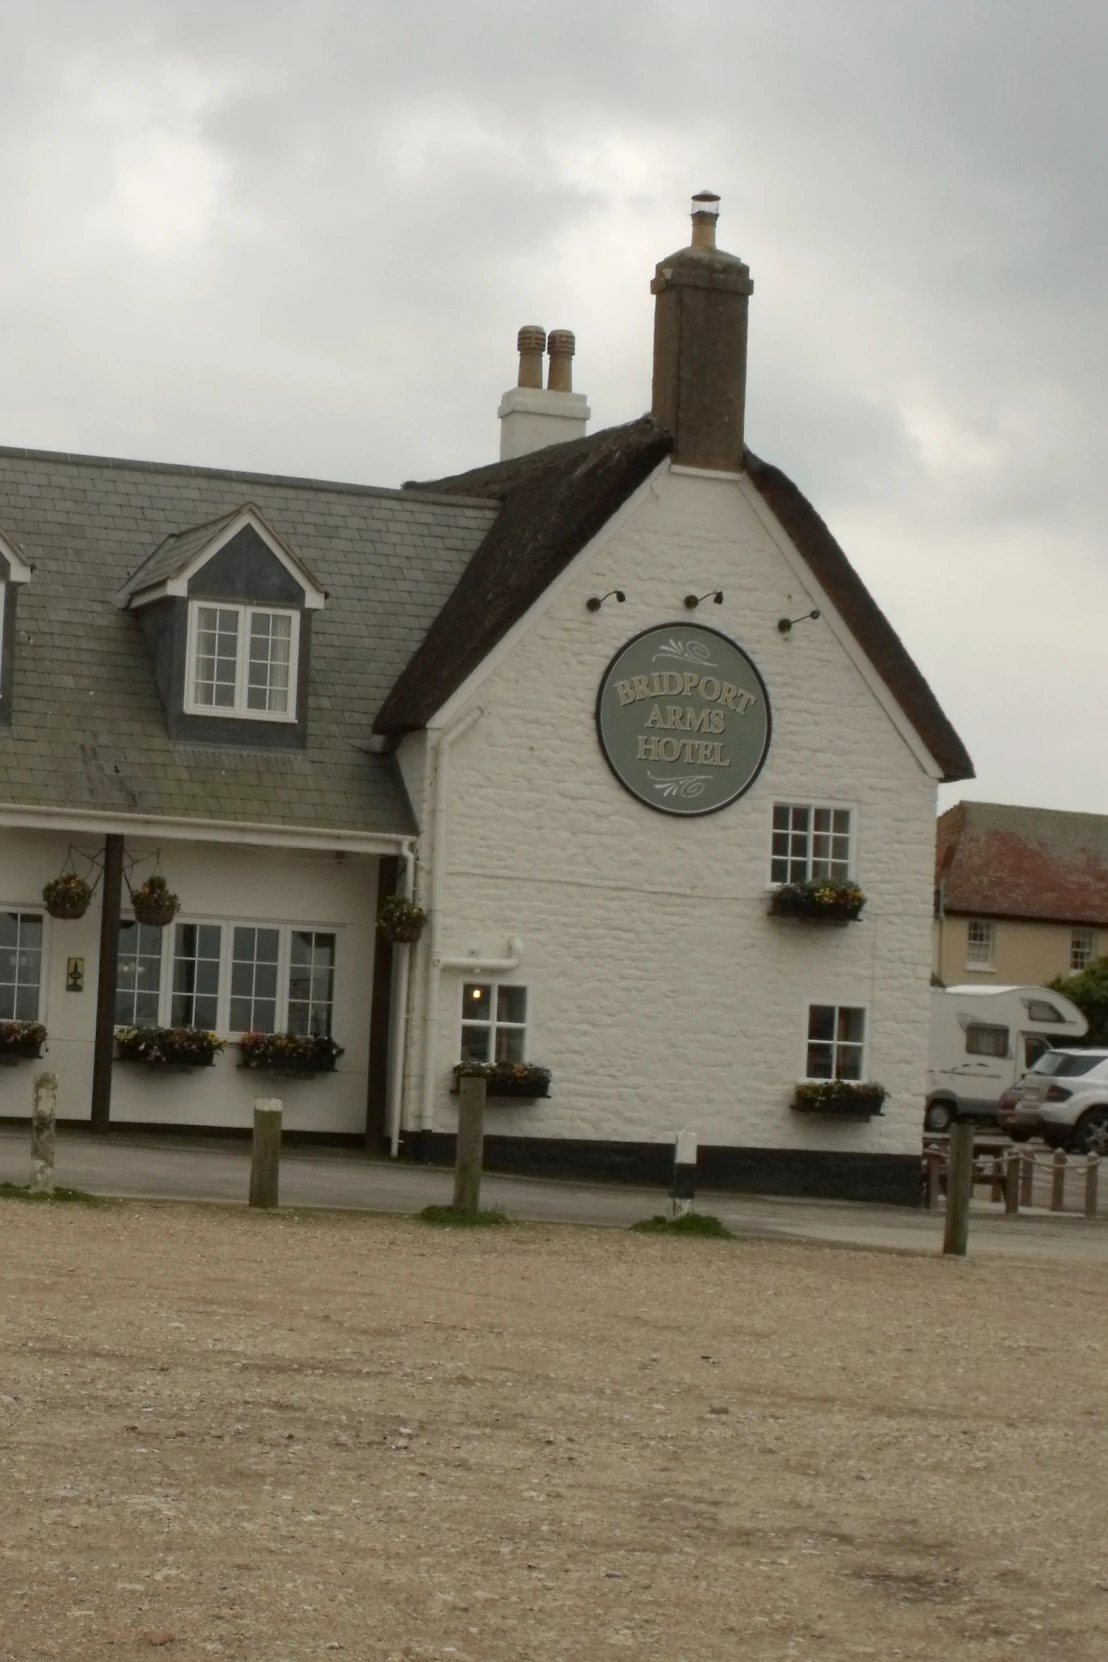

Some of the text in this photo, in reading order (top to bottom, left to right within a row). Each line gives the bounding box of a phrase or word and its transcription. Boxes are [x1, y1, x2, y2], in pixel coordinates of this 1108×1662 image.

[614, 671, 756, 715] BRIDPORT
[644, 704, 726, 734] ARMS
[636, 735, 731, 767] HOTEL
